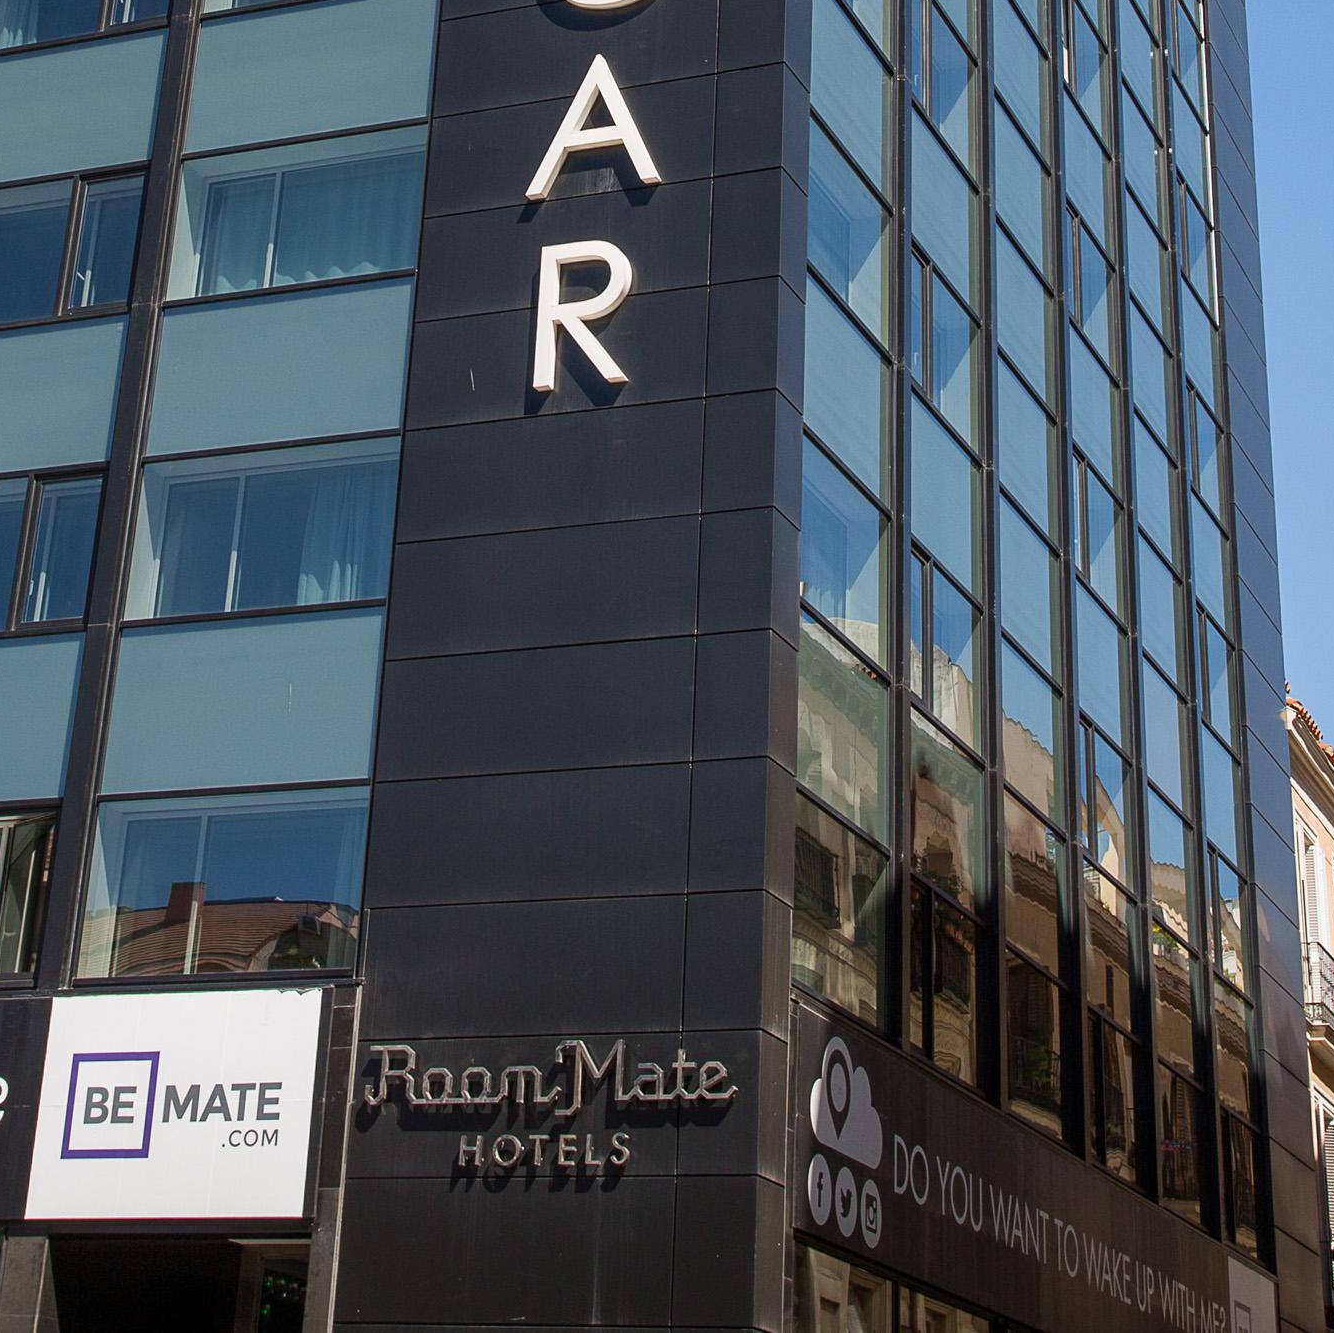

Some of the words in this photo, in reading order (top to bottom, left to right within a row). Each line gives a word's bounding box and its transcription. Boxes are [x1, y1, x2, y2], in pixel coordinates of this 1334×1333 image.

[365, 1043, 561, 1106] Room
[554, 1038, 739, 1116] Mate
[83, 1085, 138, 1125] BE
[162, 1081, 283, 1123] MATE
[221, 1129, 279, 1148] .COM
[458, 1133, 631, 1167] HOTELS
[893, 1134, 930, 1205] DO
[936, 1156, 983, 1232] YOU
[989, 1184, 1049, 1265] WANT
[1054, 1217, 1079, 1278] TO
[1083, 1233, 1132, 1305] WAKE
[1136, 1260, 1155, 1314] UP
[1158, 1271, 1196, 1333] WITH
